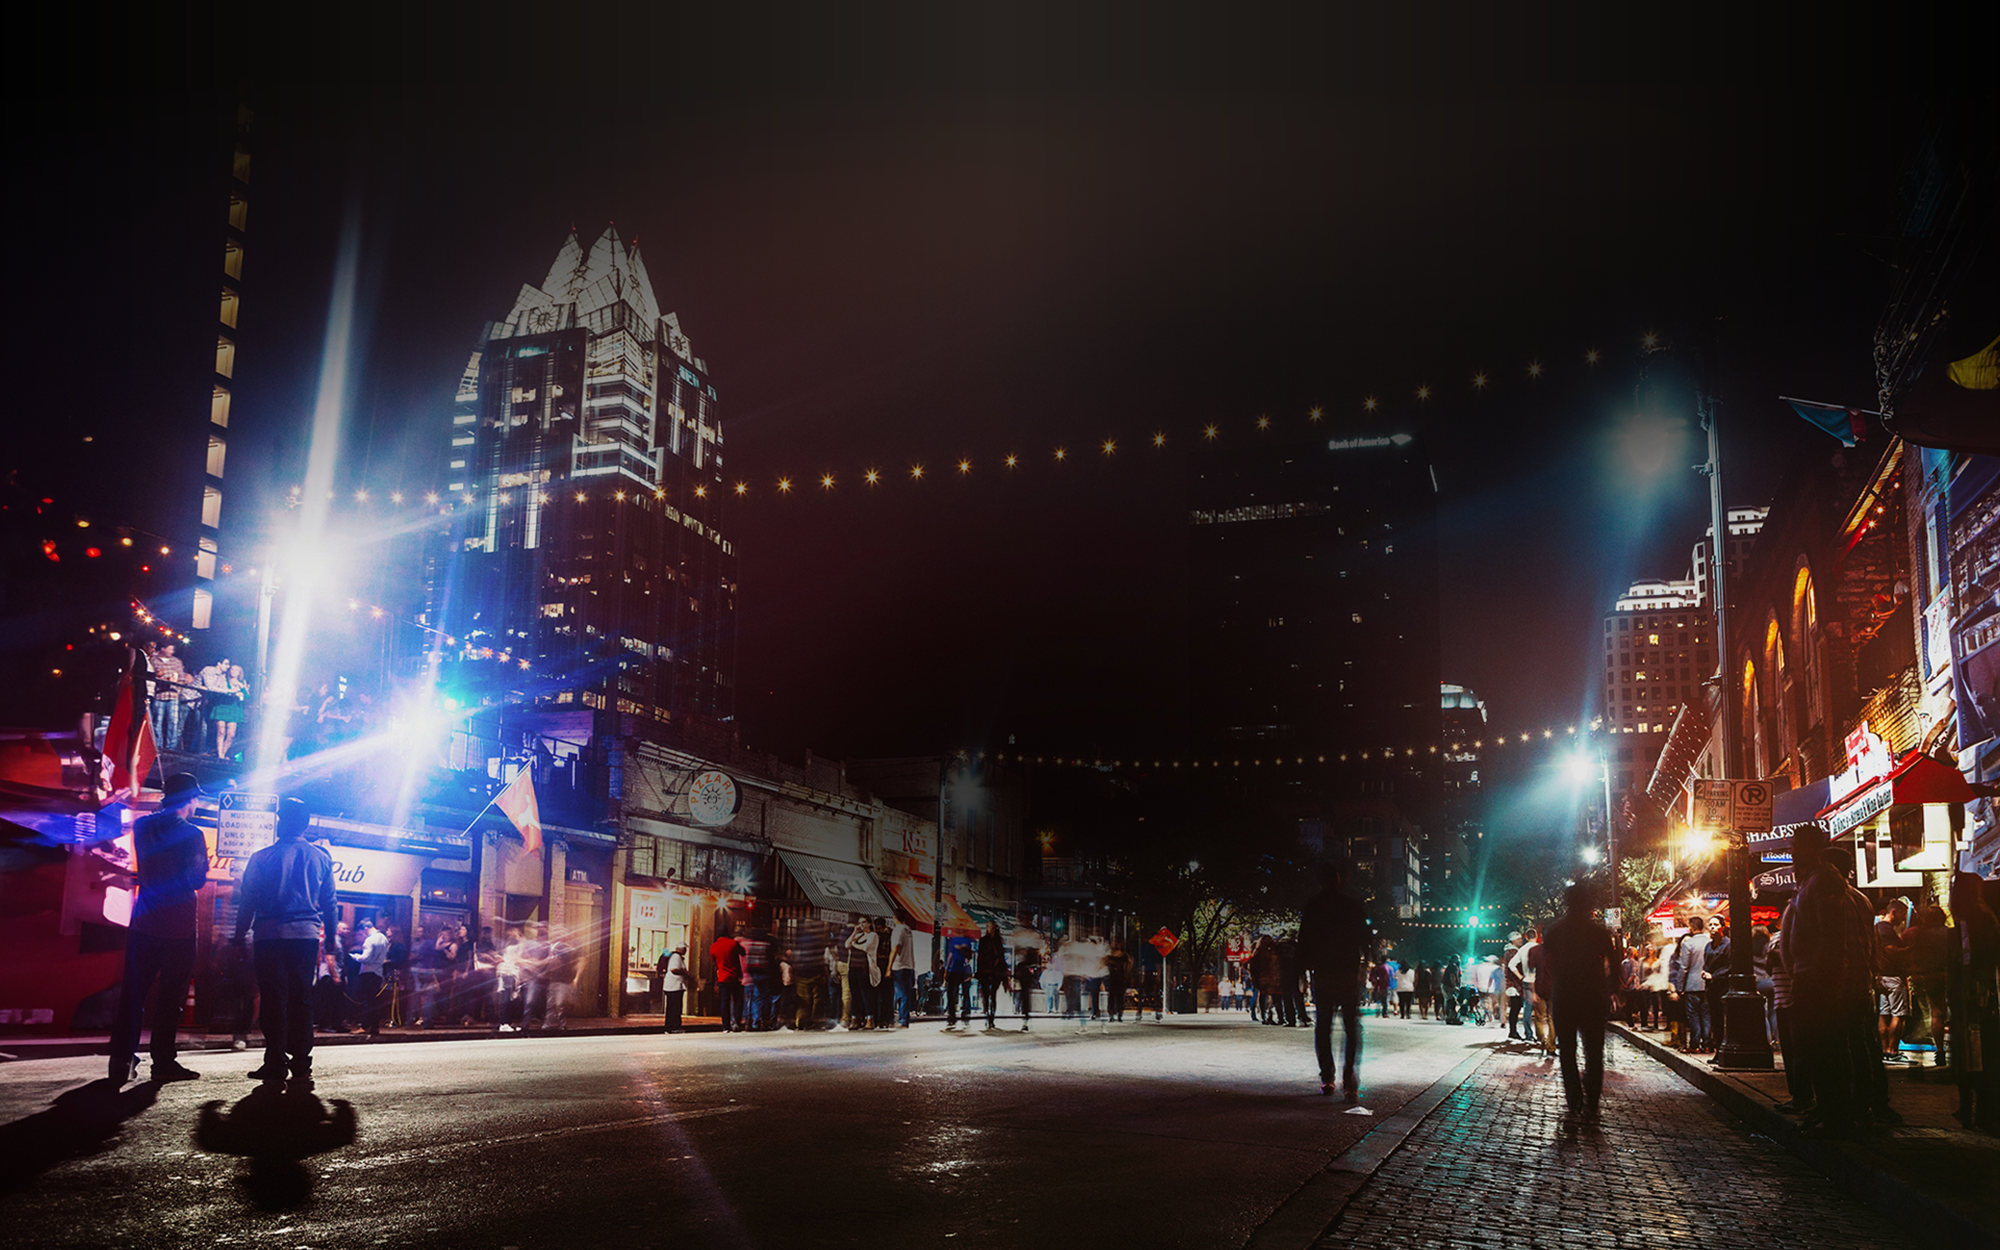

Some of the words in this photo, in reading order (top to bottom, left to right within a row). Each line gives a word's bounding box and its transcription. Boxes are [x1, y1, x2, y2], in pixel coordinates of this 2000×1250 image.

[690, 774, 734, 805] PIZZARIA
[1696, 782, 1705, 797] 2
[1706, 789, 1729, 798] PARKING
[230, 812, 266, 820] MUSICIAN
[1707, 807, 1717, 815] TO
[220, 821, 254, 830] LOADING
[258, 823, 274, 831] AND
[224, 831, 269, 840] UNLODING
[331, 861, 365, 884] Pub
[571, 869, 588, 882] ATM
[820, 878, 869, 897] 311
